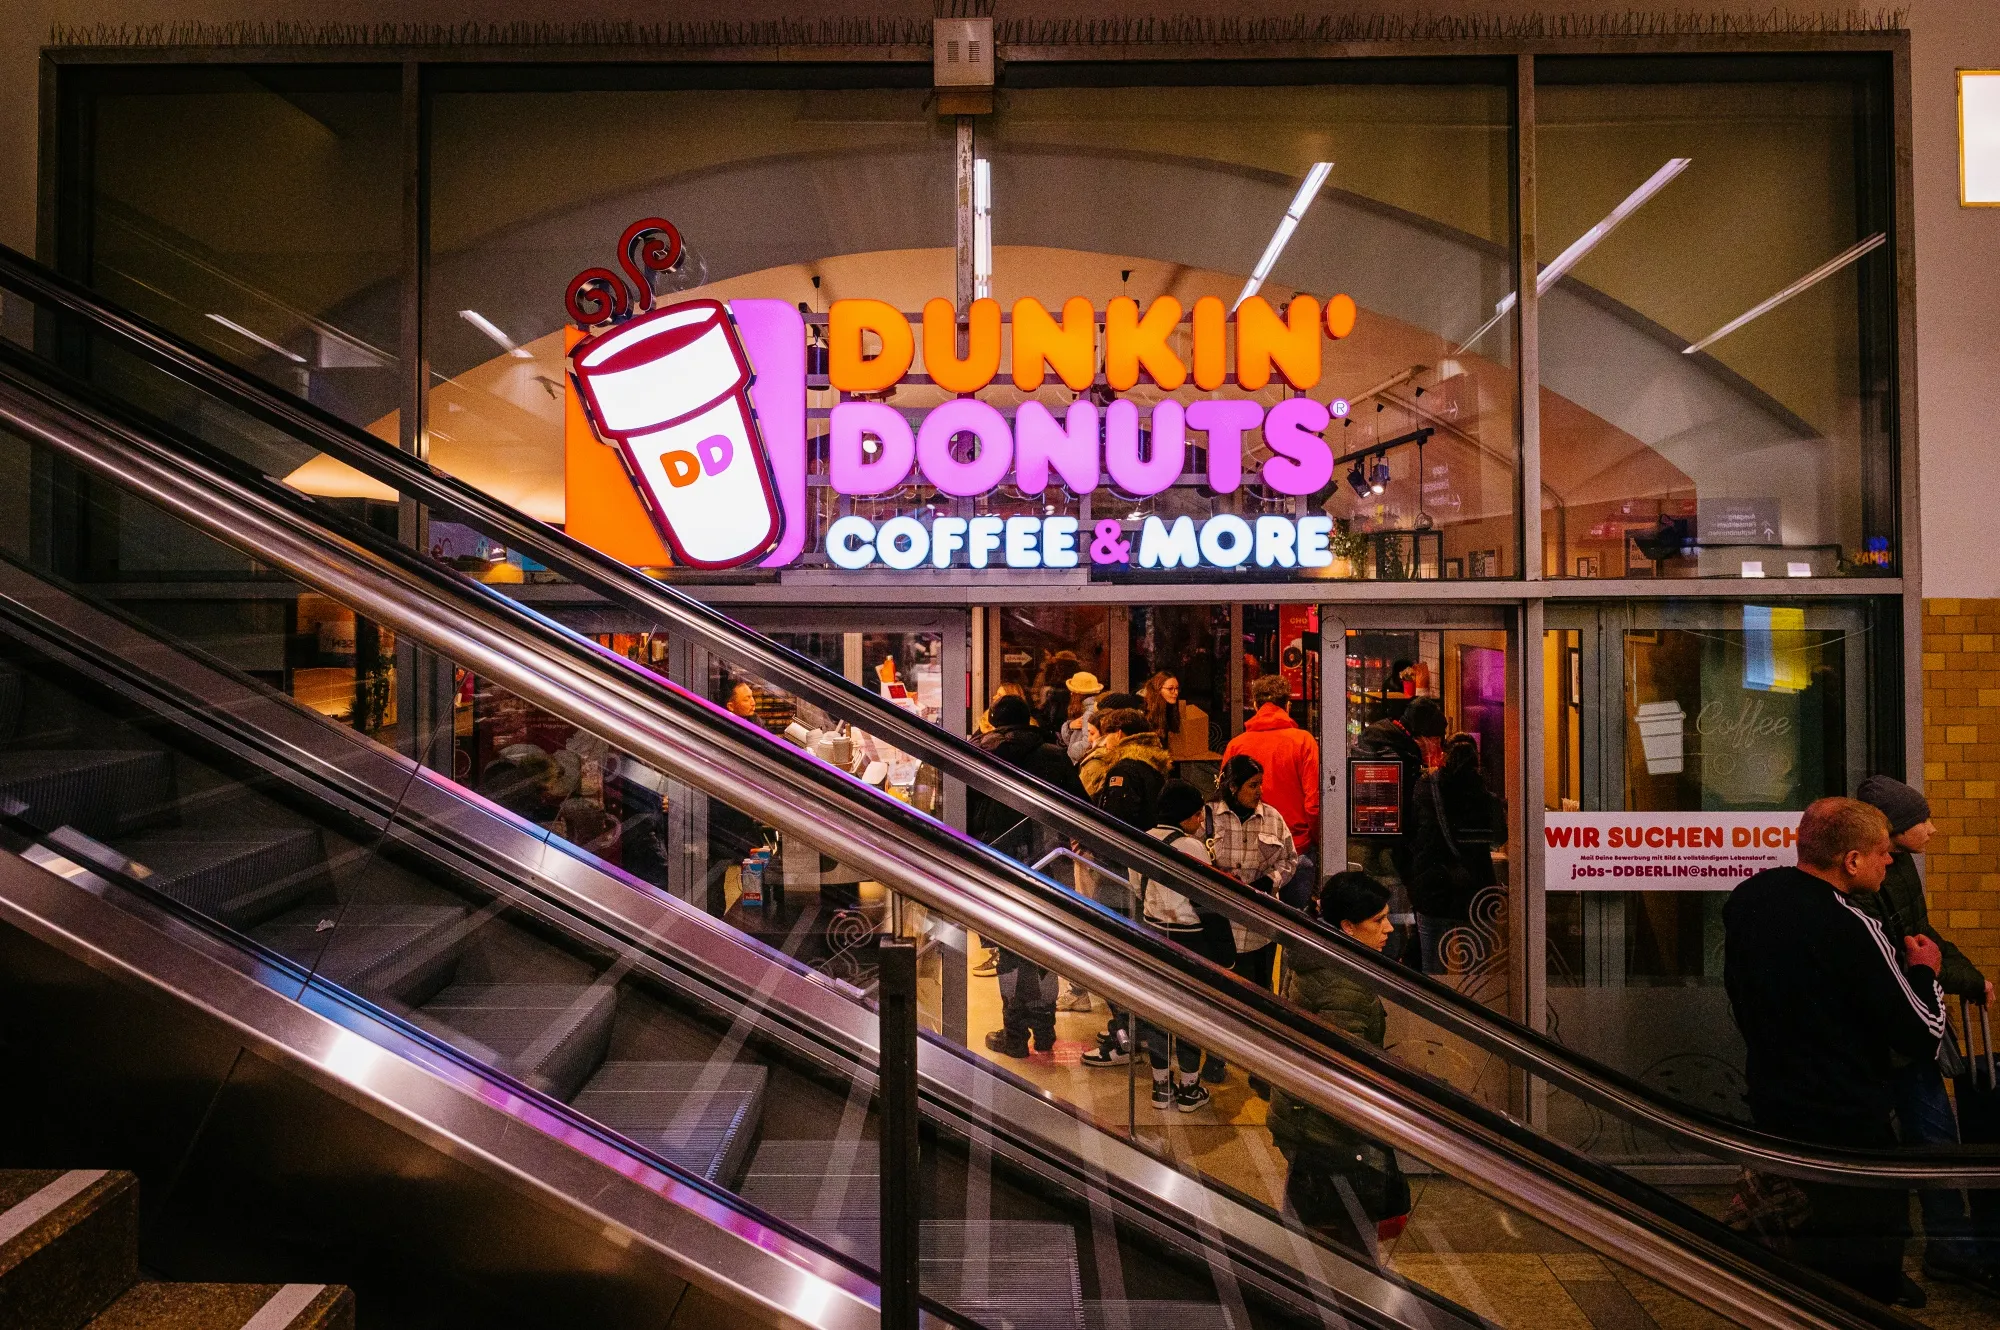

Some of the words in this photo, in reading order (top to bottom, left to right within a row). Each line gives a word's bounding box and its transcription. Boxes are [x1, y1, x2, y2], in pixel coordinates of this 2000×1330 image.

[828, 293, 1357, 393] DUNKIN'
[659, 434, 734, 488] DD
[829, 397, 1335, 497] DONUTS
[826, 515, 1079, 570] COFFEE
[1090, 518, 1131, 565] &
[1138, 513, 1334, 568] MORE
[1696, 697, 1792, 749] Coffee
[1544, 826, 1600, 848] WIR
[1607, 826, 1724, 848] SUCHEN
[1732, 826, 1799, 848] DICH
[1614, 854, 1651, 862] Bewerbung
[1683, 854, 1729, 862] vollständigem
